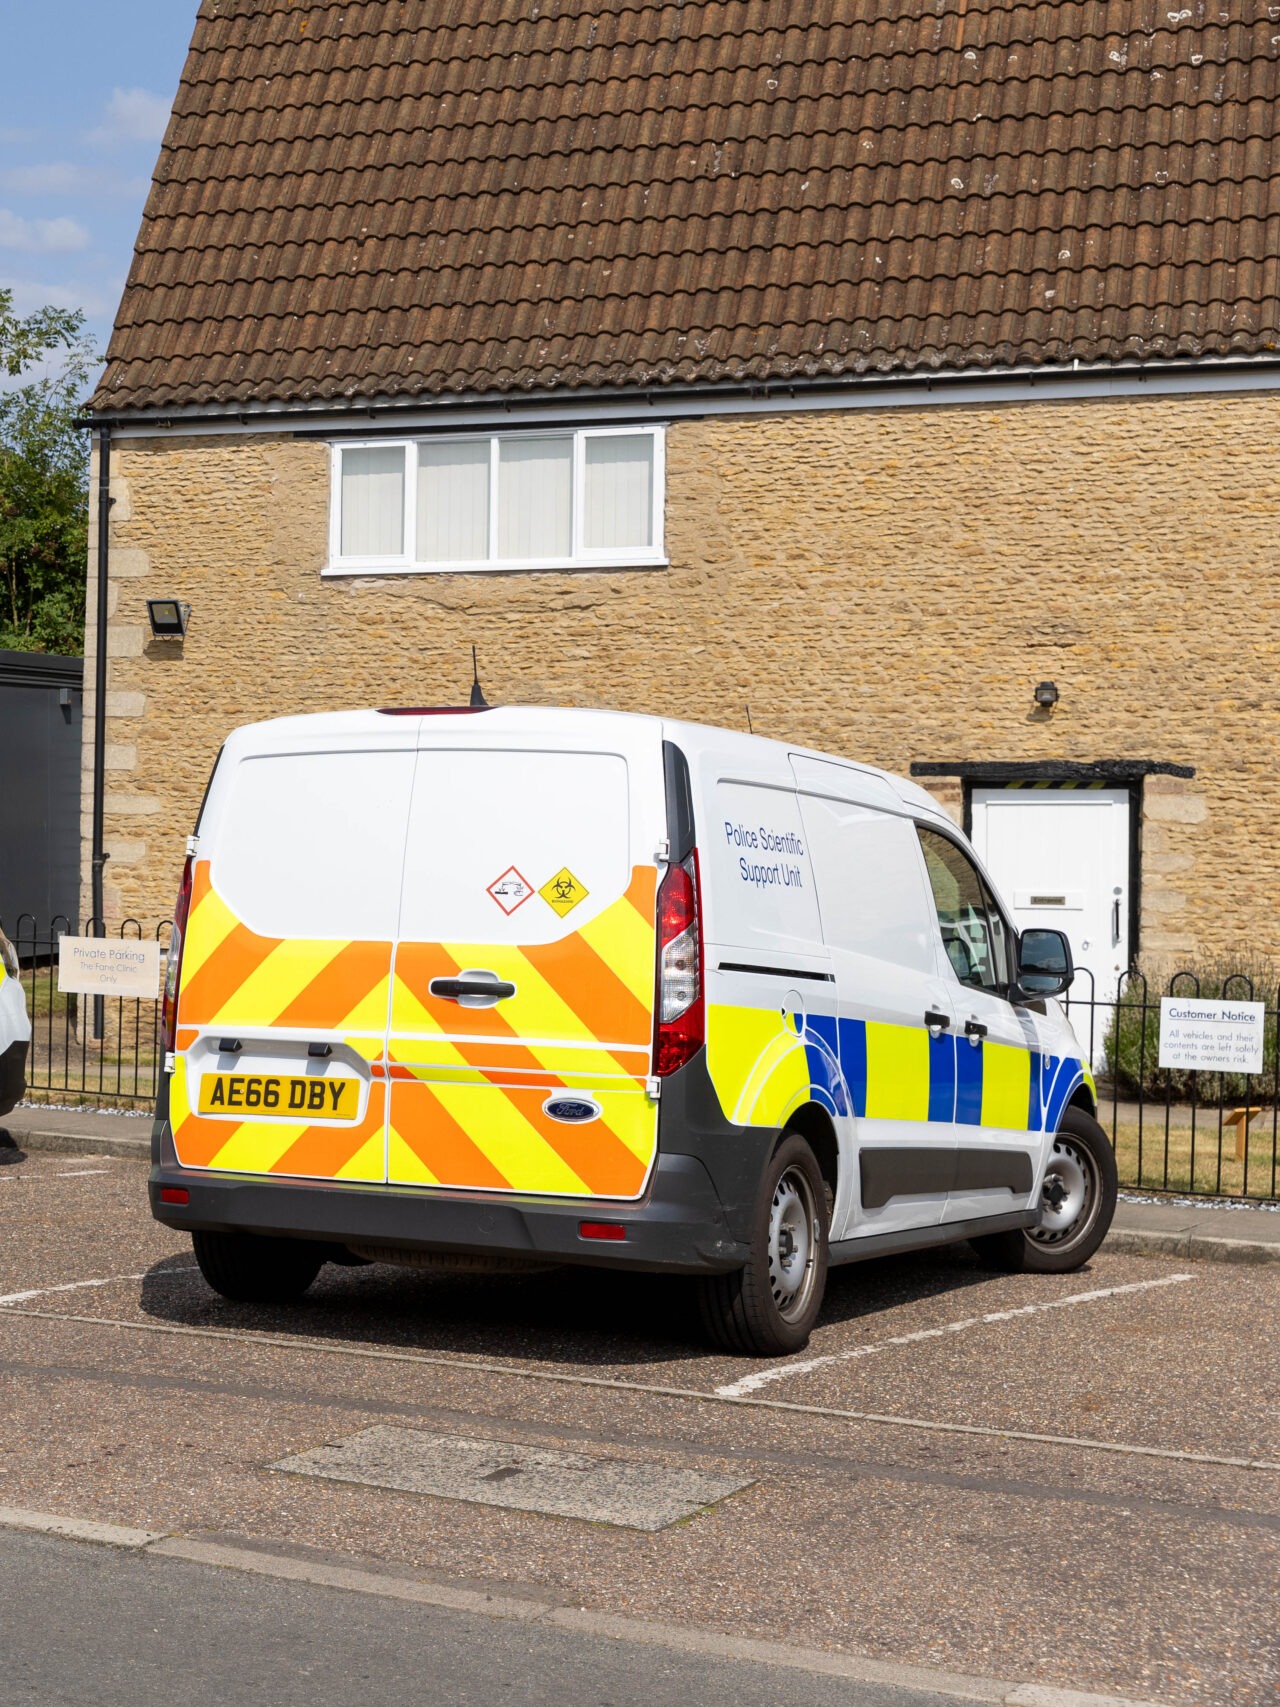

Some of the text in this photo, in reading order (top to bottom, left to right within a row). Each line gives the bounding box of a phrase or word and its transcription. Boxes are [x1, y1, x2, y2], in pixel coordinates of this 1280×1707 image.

[724, 821, 804, 856] Police Scientific
[739, 857, 803, 889] Support Unit
[73, 947, 145, 963] Private Parking
[80, 961, 137, 973] The Fane Clinic
[100, 974, 117, 984] Only
[1169, 1007, 1256, 1022] Customer Notice
[1169, 1029, 1254, 1042] All vehicles and their
[1163, 1042, 1198, 1050] contents
[1218, 1043, 1232, 1051] left
[1235, 1044, 1259, 1055] solely
[1172, 1052, 1181, 1060] at
[1184, 1052, 1197, 1061] the
[1200, 1055, 1230, 1063] owners
[210, 1077, 346, 1111] AE66 DBY
[556, 1102, 585, 1116] Ford
